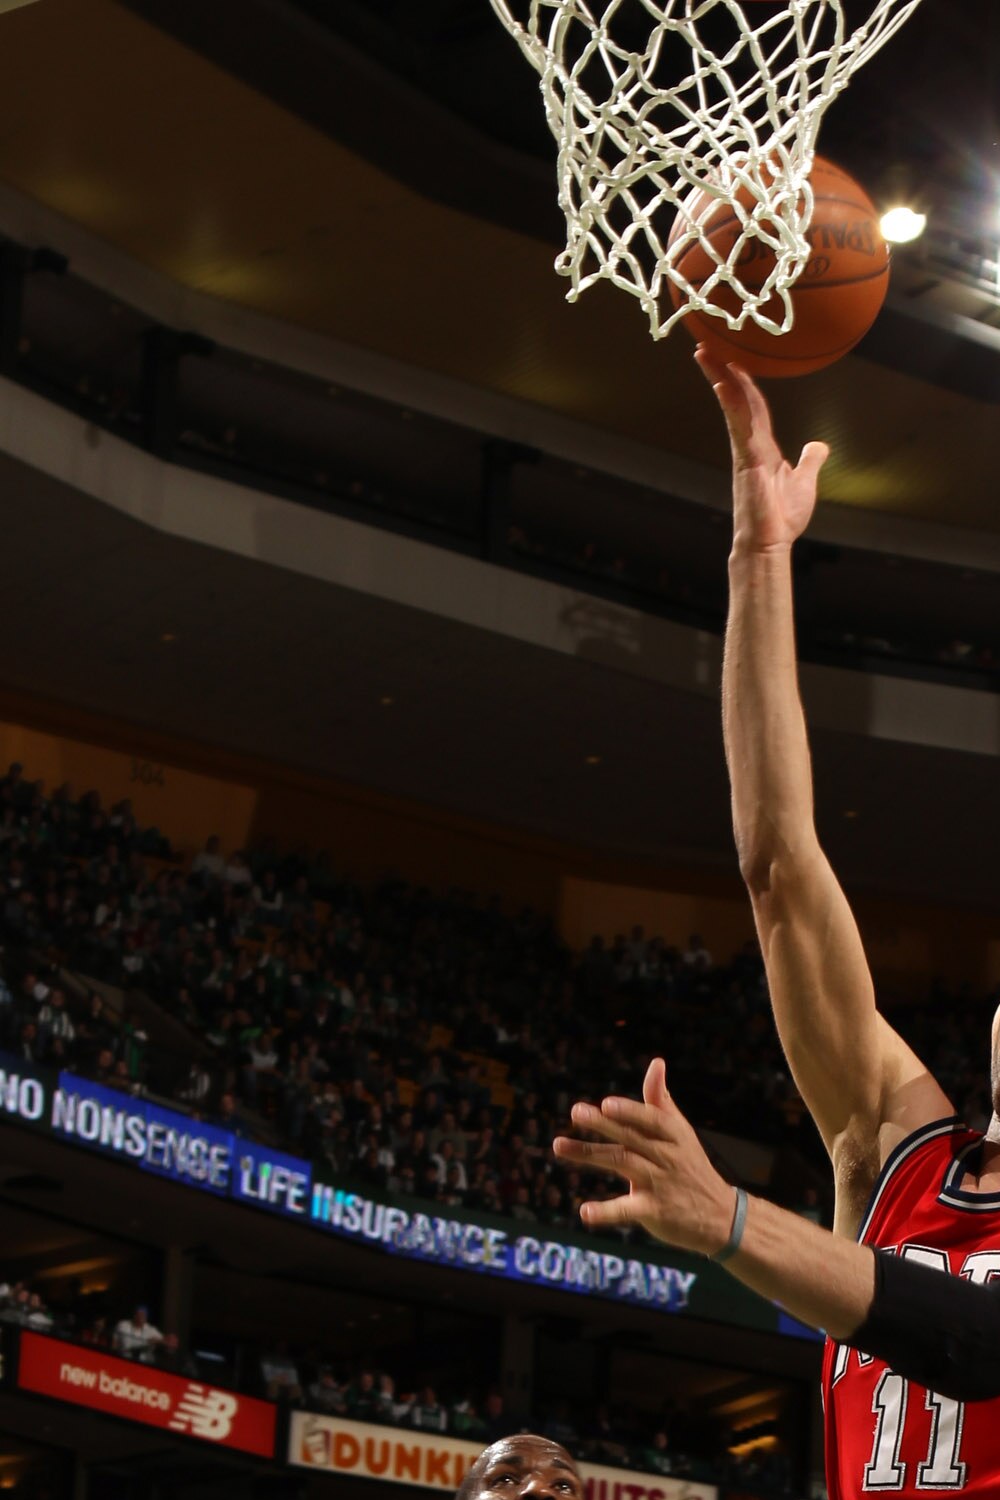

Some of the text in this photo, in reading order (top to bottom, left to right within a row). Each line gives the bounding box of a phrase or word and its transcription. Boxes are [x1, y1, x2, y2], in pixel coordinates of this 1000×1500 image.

[0, 1067, 697, 1306] NO NONSENSE LIFE INSURANCE COMPANY
[60, 1363, 96, 1389] new
[99, 1368, 170, 1411] balance
[862, 1368, 966, 1491] 11
[333, 1432, 479, 1488] DUNKI
